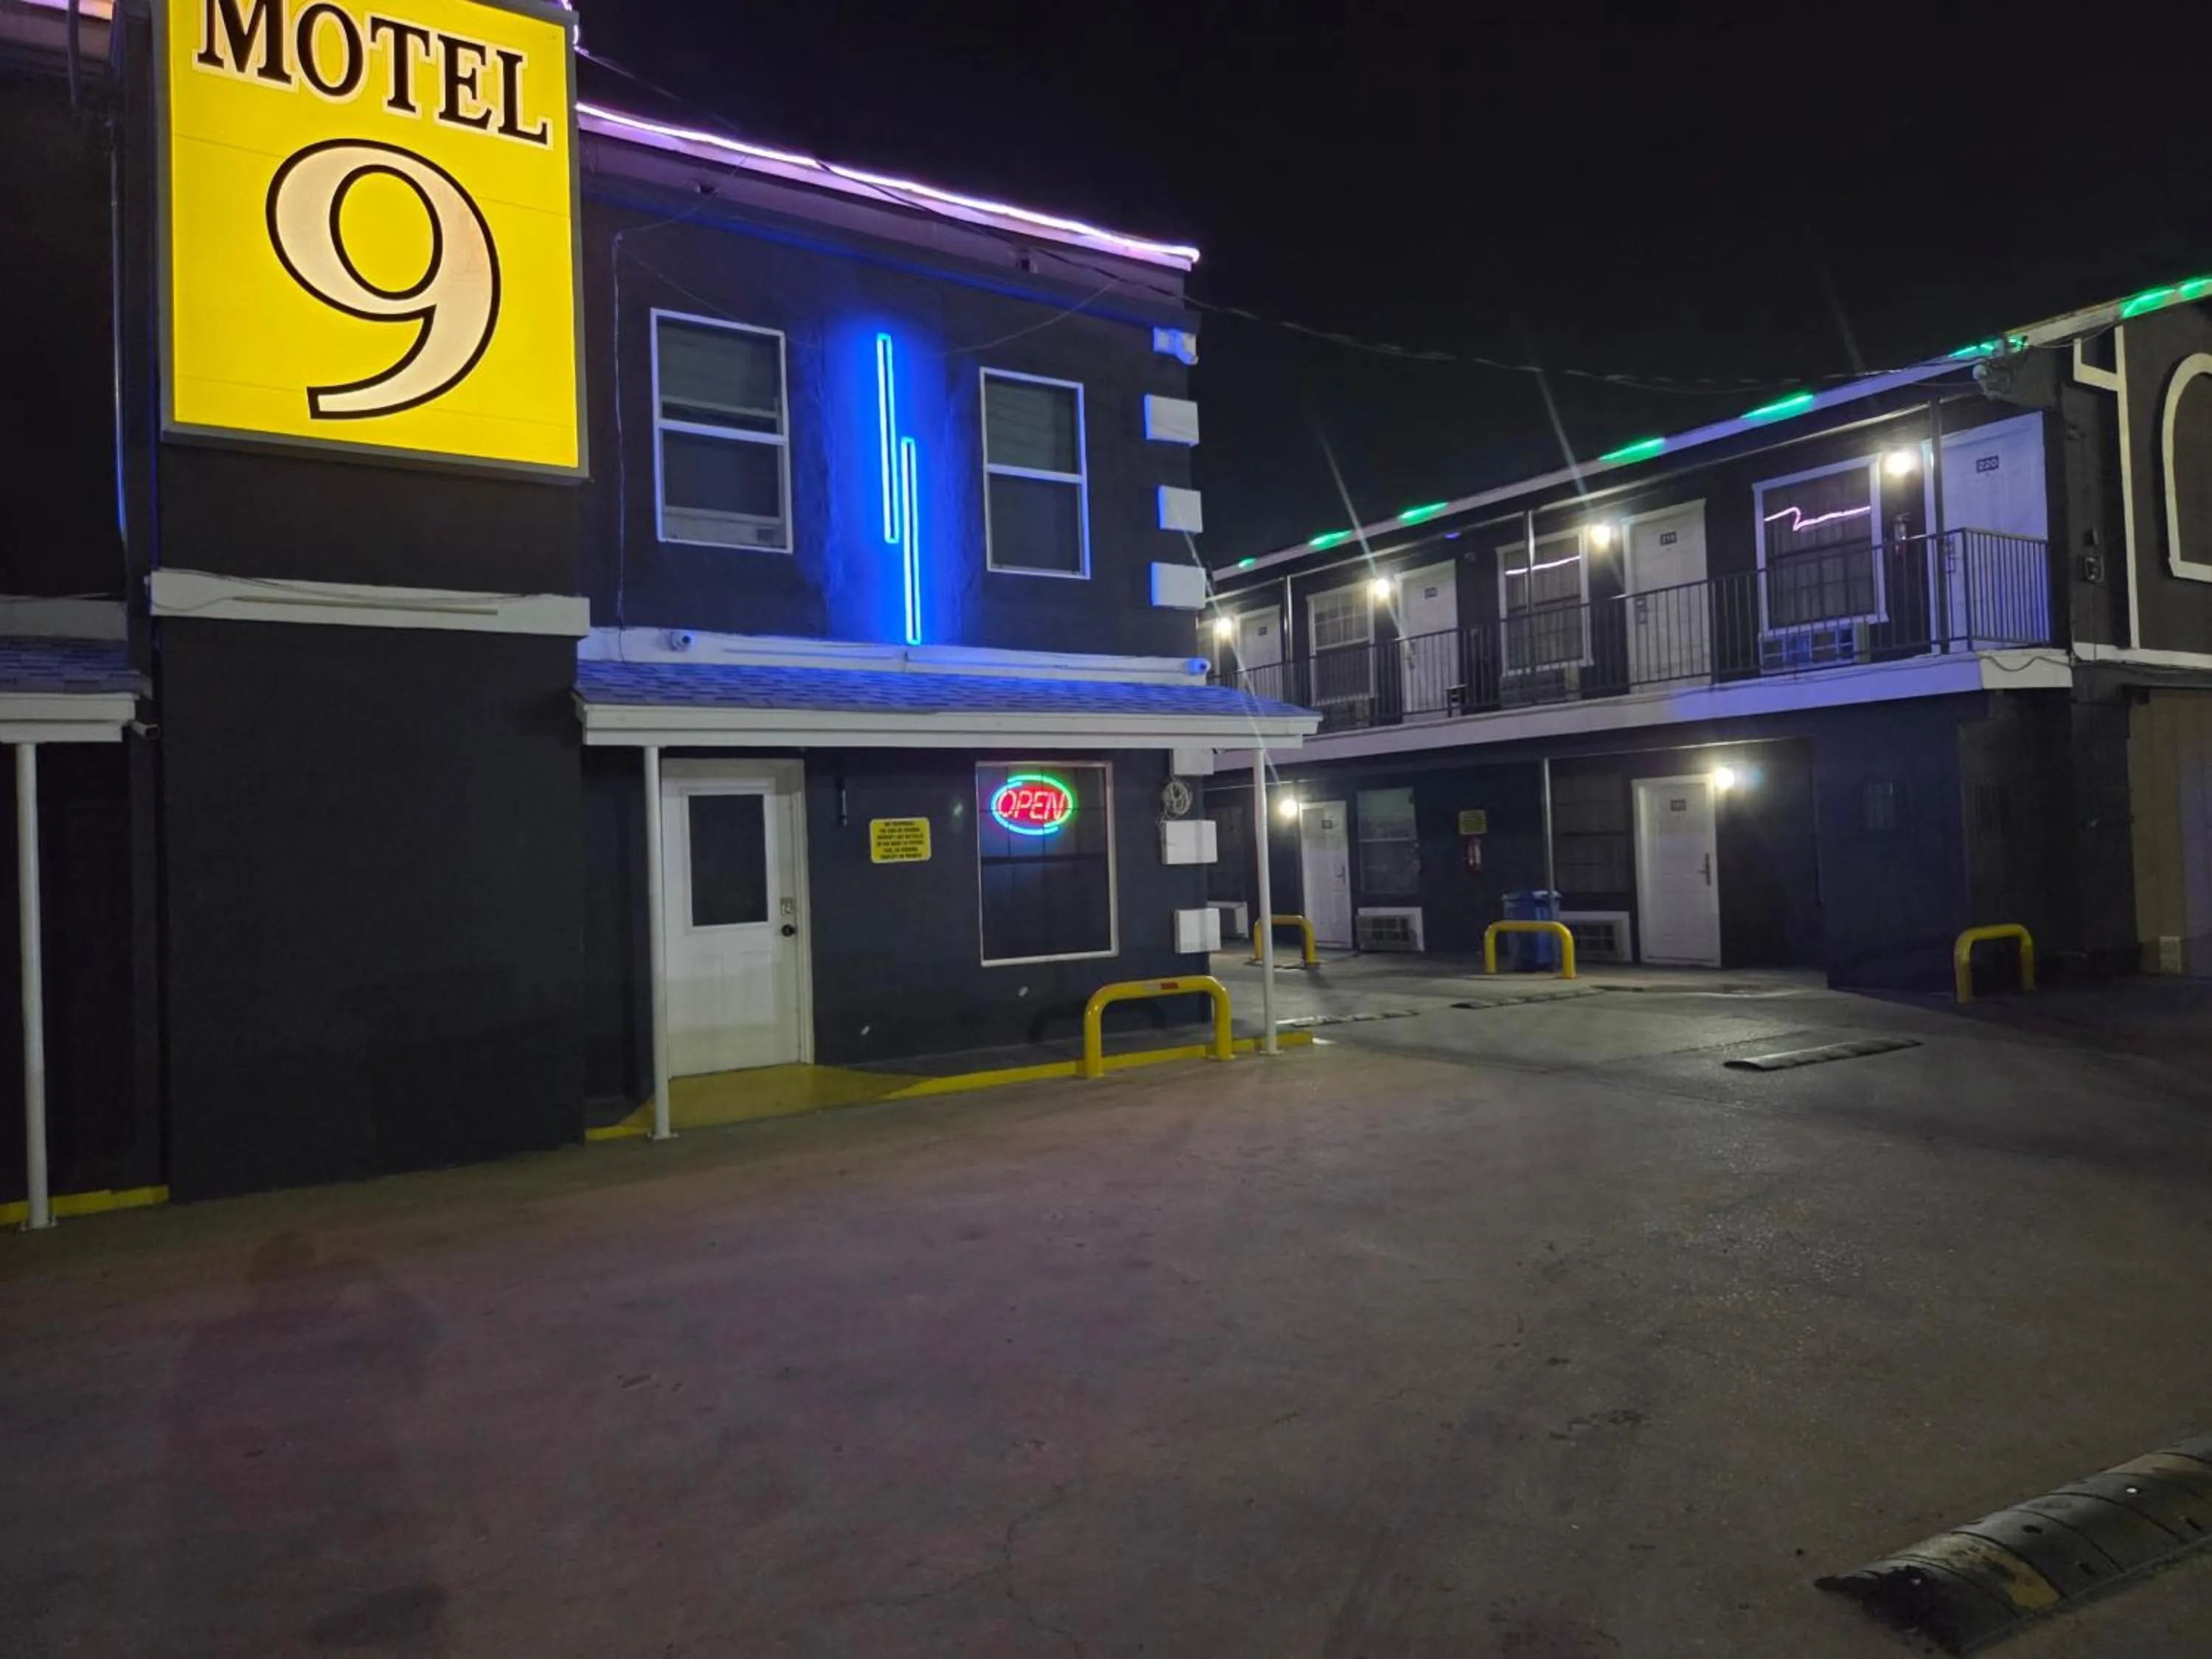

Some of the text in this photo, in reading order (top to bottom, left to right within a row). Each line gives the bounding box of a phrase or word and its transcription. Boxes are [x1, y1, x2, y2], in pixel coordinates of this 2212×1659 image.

[195, 0, 550, 147] MOTEL
[265, 138, 501, 420] 9
[998, 790, 1066, 820] OPEN
